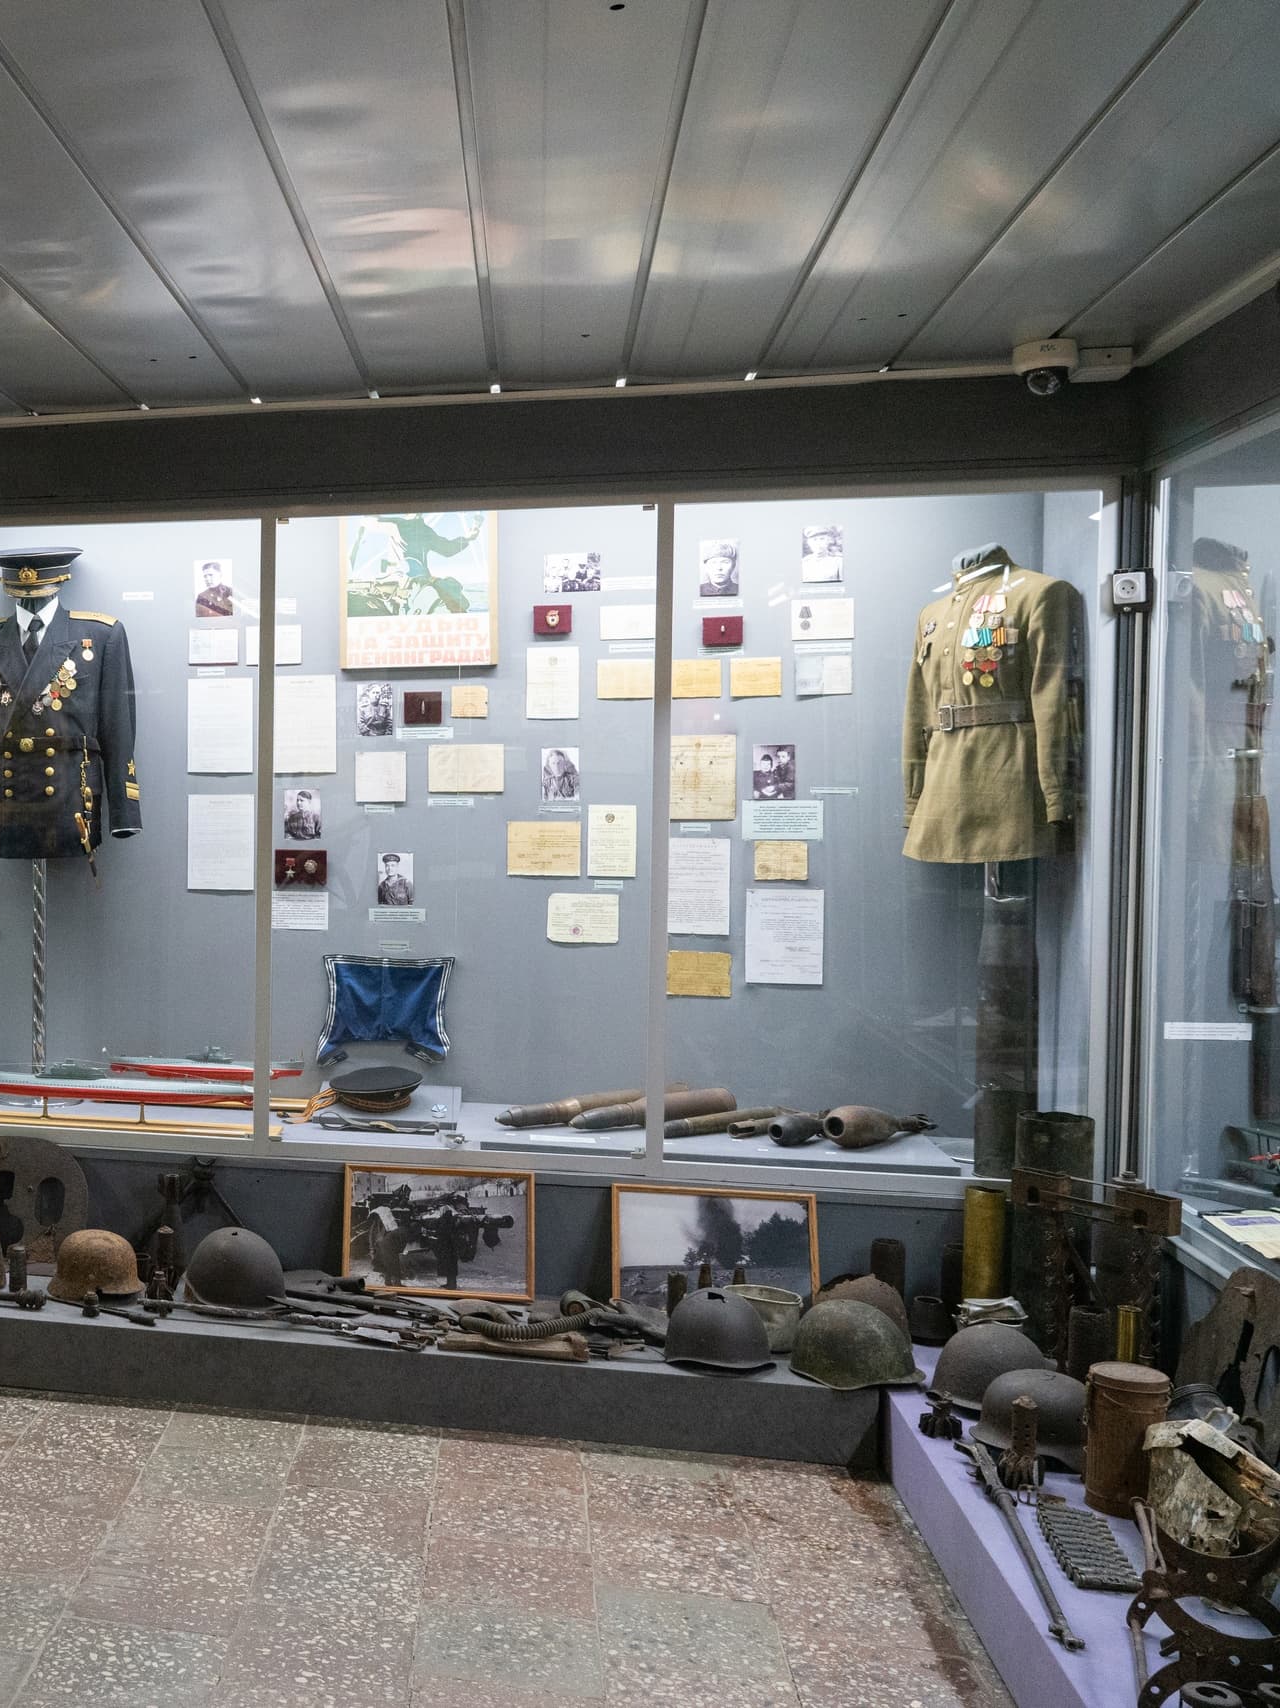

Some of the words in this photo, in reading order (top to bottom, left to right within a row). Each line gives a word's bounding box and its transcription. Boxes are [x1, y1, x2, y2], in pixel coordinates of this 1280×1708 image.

[357, 616, 480, 635] ГРУДЬЮ
[348, 636, 379, 650] НА
[348, 649, 491, 666] ЛЕНИНГРАДА!
